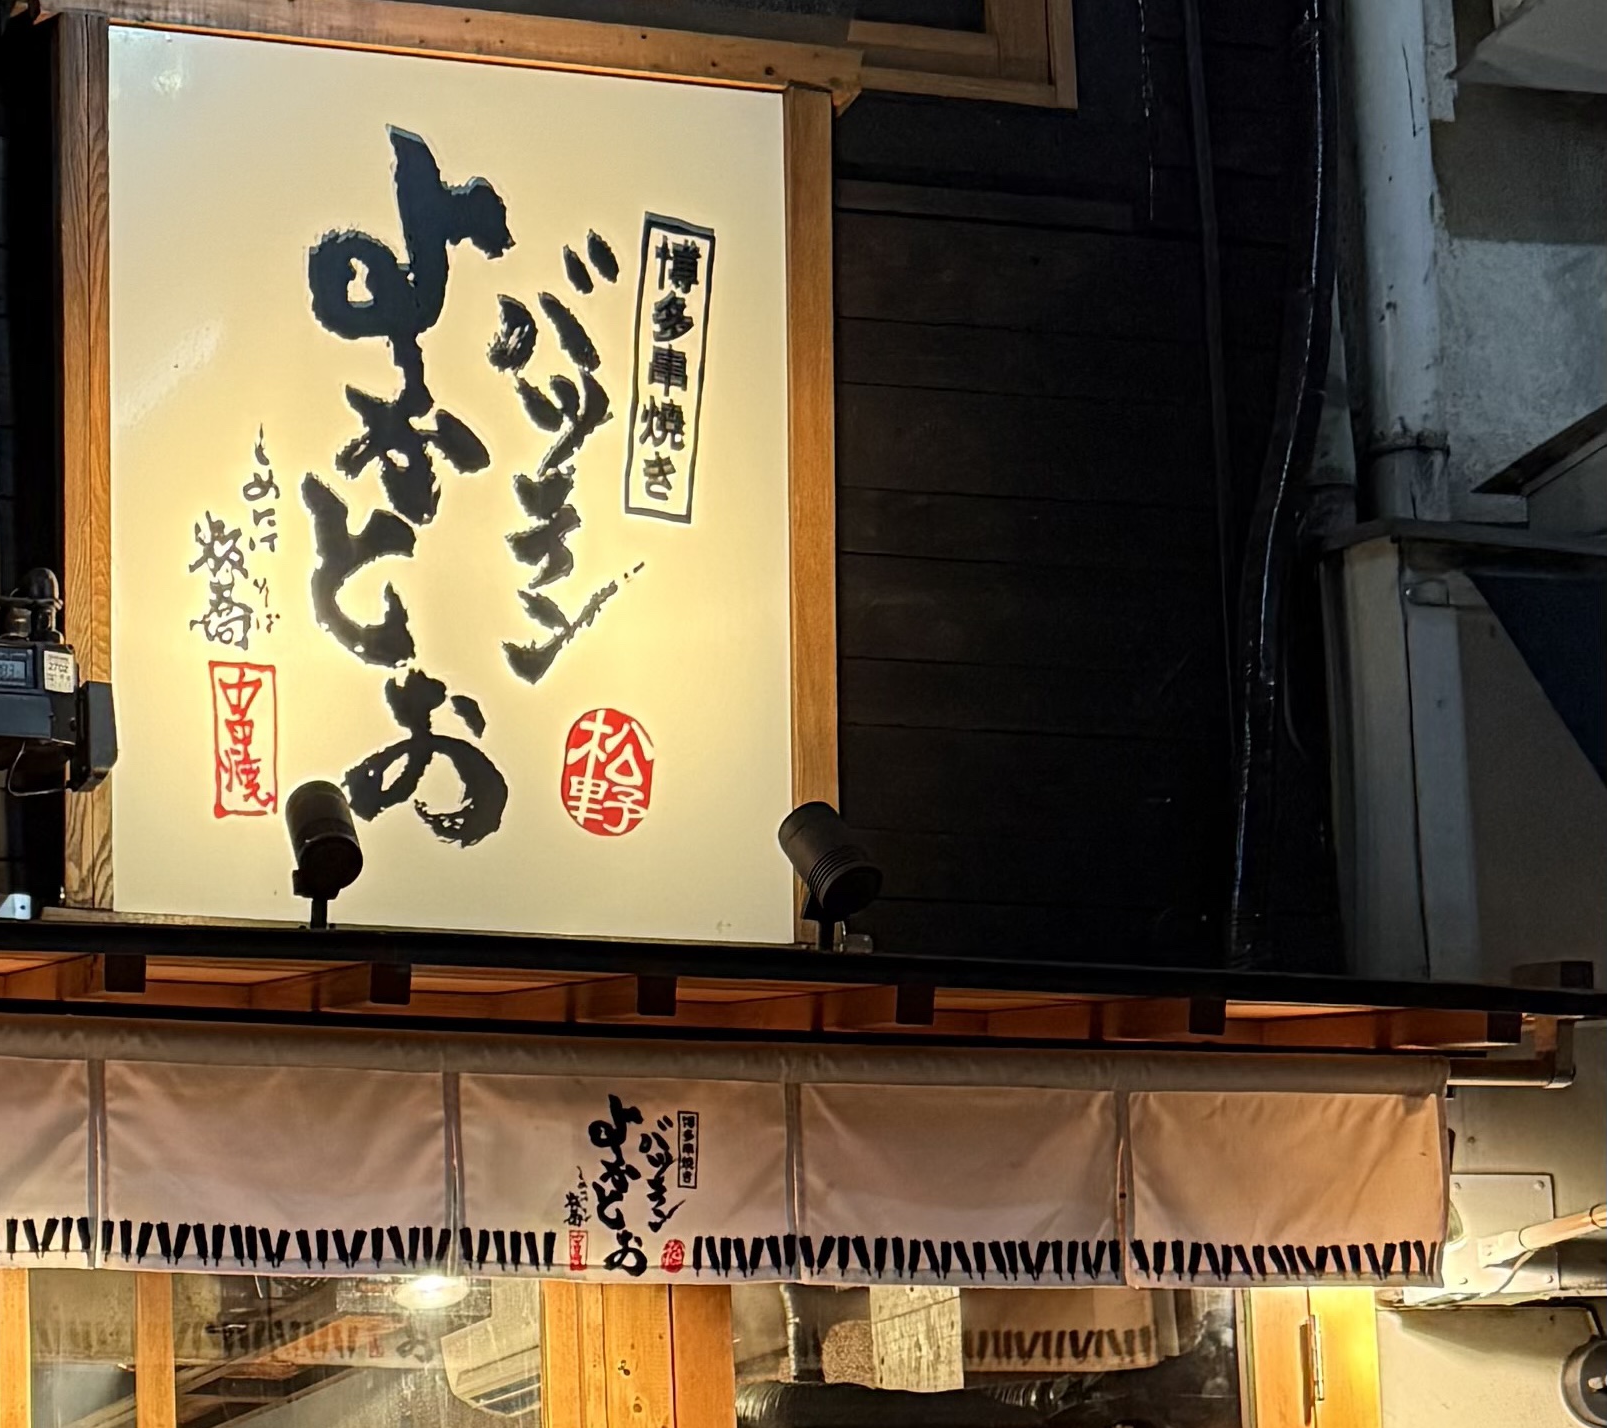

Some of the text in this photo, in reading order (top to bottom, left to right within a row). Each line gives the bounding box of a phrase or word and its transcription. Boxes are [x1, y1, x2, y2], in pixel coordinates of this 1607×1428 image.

[639, 235, 701, 500] 博多串焼き
